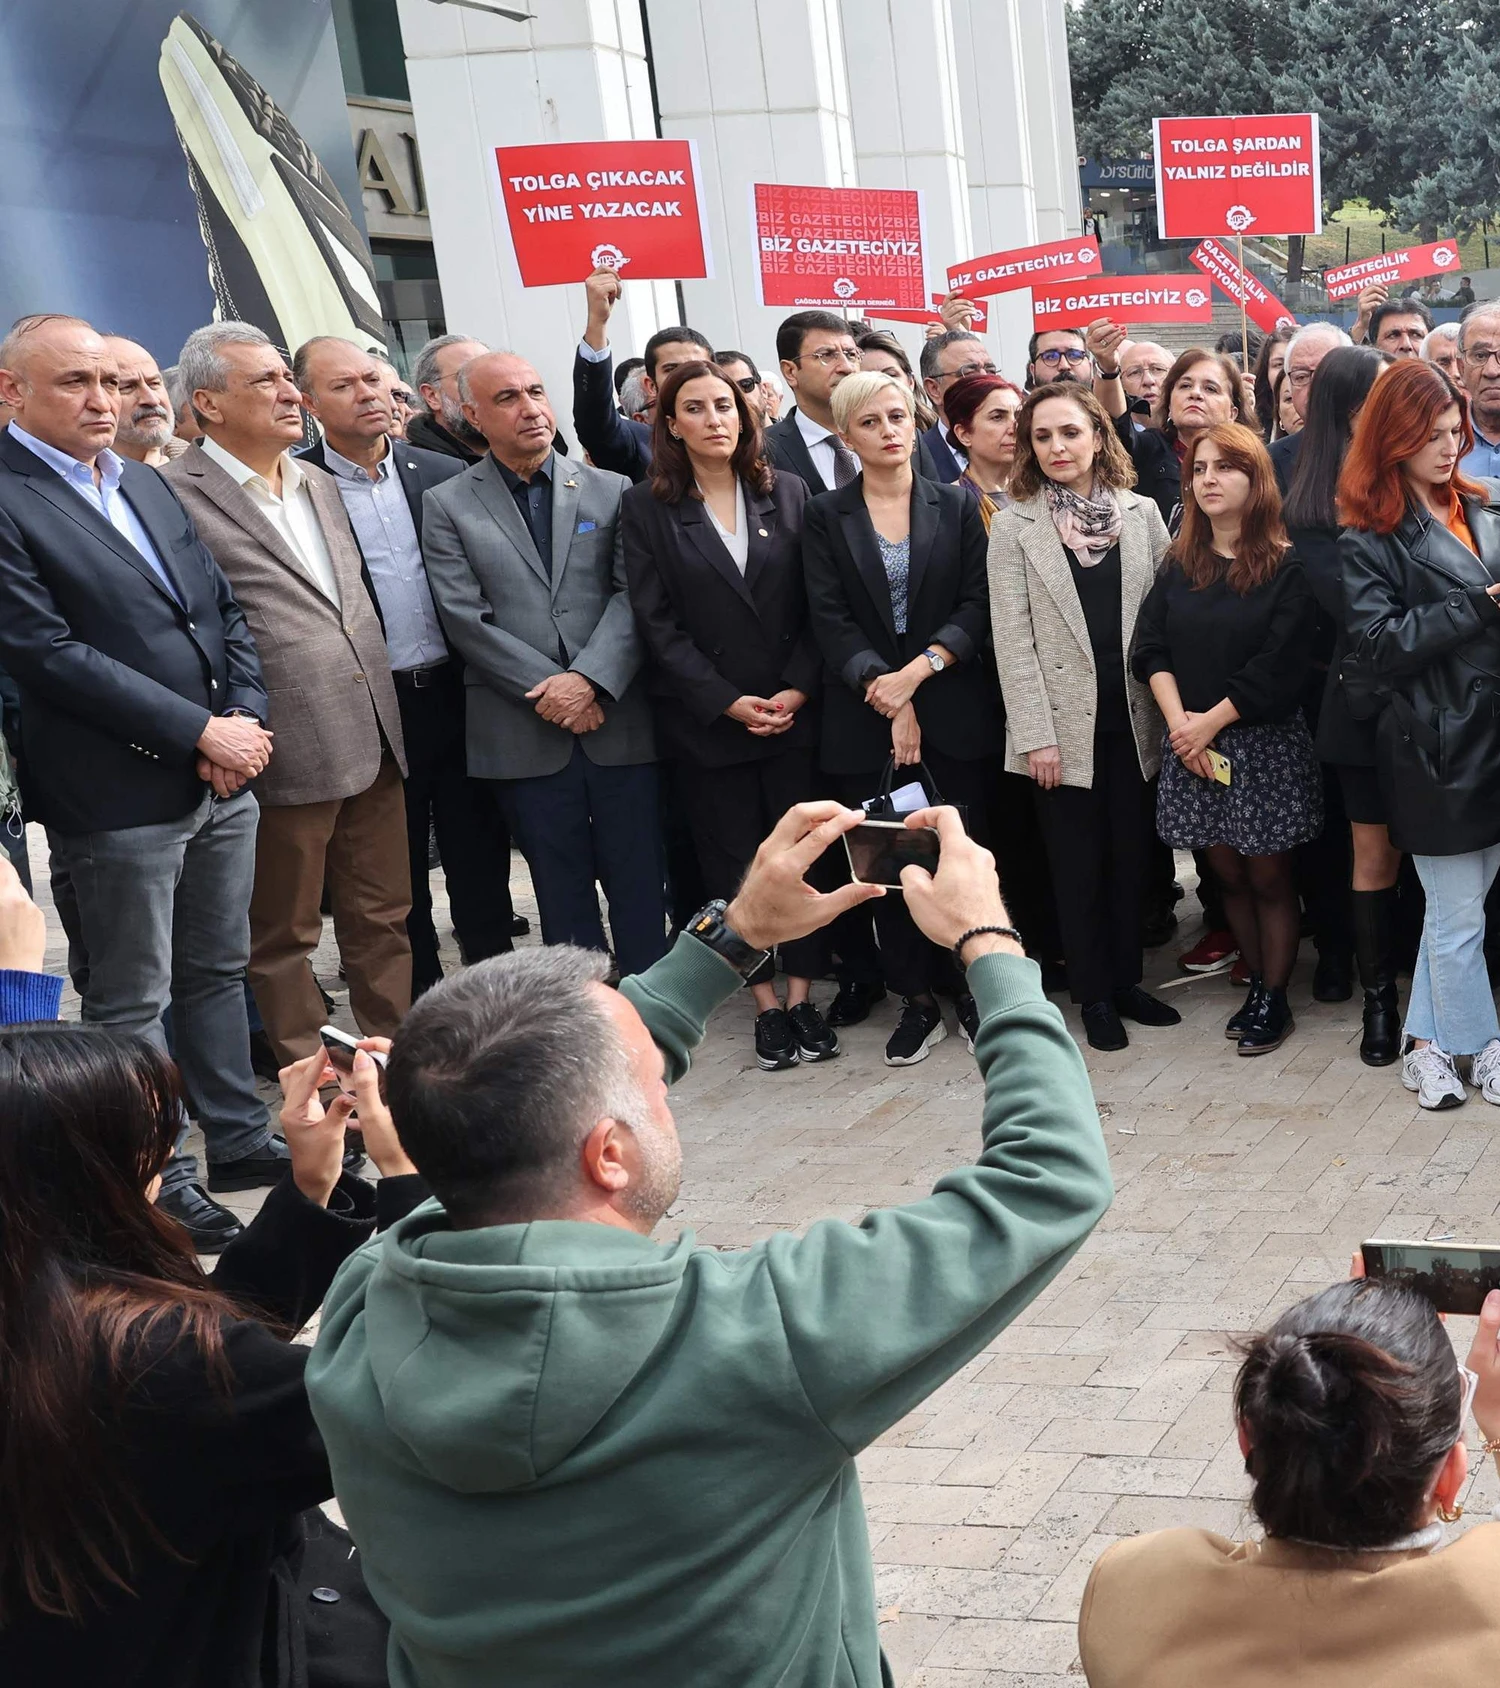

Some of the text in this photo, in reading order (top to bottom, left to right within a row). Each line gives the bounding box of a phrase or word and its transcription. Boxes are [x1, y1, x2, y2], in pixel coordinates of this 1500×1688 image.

[1171, 136, 1301, 155] TOLGA ŞARDAN
[508, 170, 686, 192] TOLGA ÇIKACAK
[1165, 160, 1310, 180] YALNIZ DEĞİLDİR
[522, 201, 682, 223] YİNE YAZACAK
[759, 209, 786, 224] BİZ
[761, 234, 919, 255] BİZ GAZETECİYİZ
[949, 252, 1075, 290] BİZ GAZETECİYİZ
[1203, 238, 1268, 304] GAZETECİLİK
[1326, 251, 1410, 284] GAZETECİLİK
[1329, 269, 1400, 298] YAPIYORUZ
[1034, 288, 1181, 315] BİZ GAZETECİYİZ
